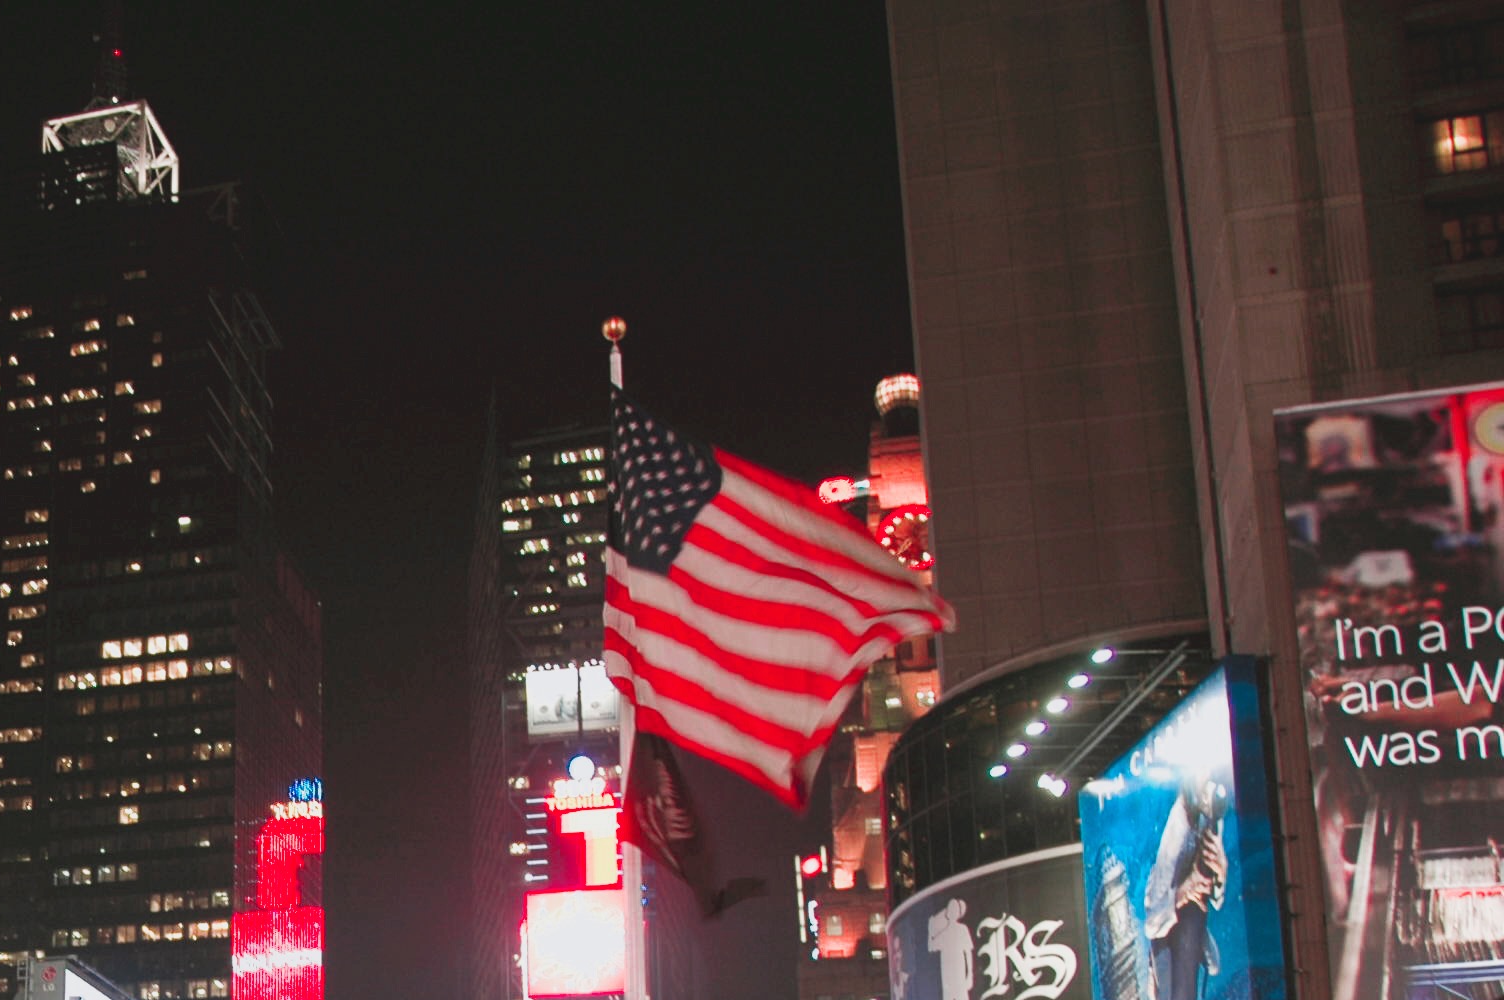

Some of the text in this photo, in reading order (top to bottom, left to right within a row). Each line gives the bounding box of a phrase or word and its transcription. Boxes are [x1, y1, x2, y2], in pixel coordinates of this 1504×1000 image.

[1335, 605, 1504, 661] I'm a P
[1341, 662, 1434, 715] and
[1344, 729, 1441, 769] was
[546, 794, 614, 811] TOSHIBA
